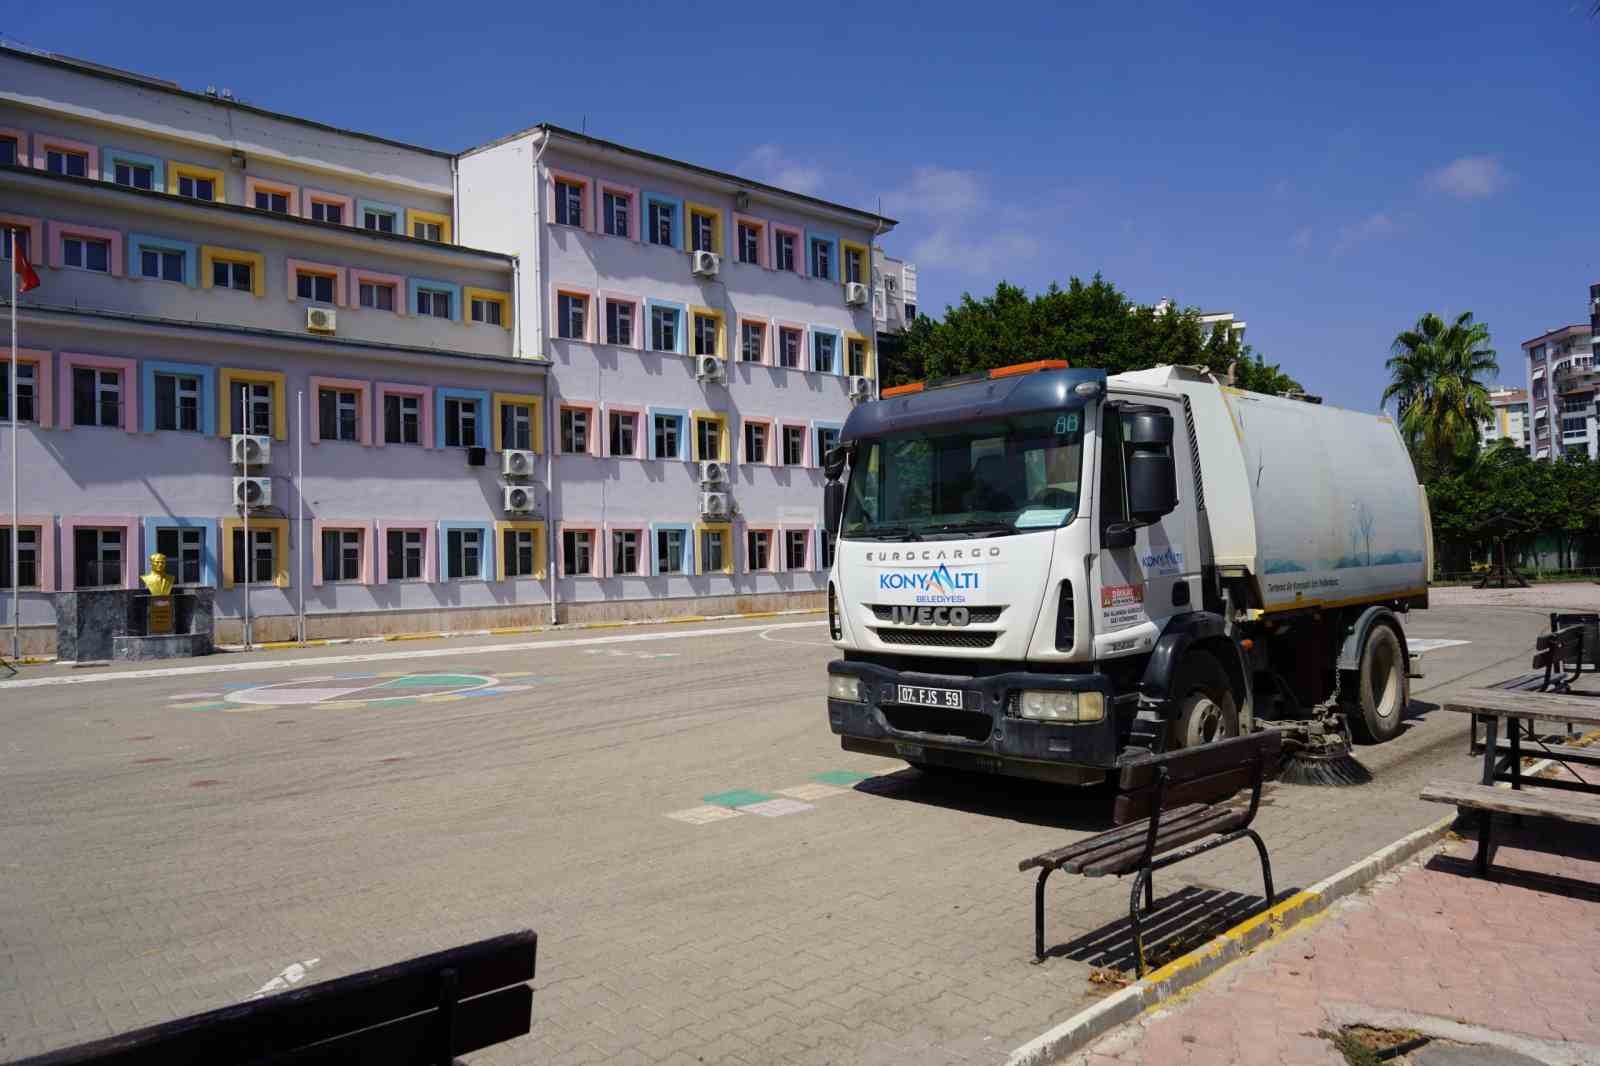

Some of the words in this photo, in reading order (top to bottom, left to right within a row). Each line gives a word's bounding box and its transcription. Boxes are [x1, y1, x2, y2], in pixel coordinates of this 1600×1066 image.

[866, 547, 1000, 562] EUROCARGO
[892, 606, 970, 627] IVECO
[902, 687, 913, 702] 07
[919, 689, 938, 705] FJS
[945, 691, 959, 706] 59
